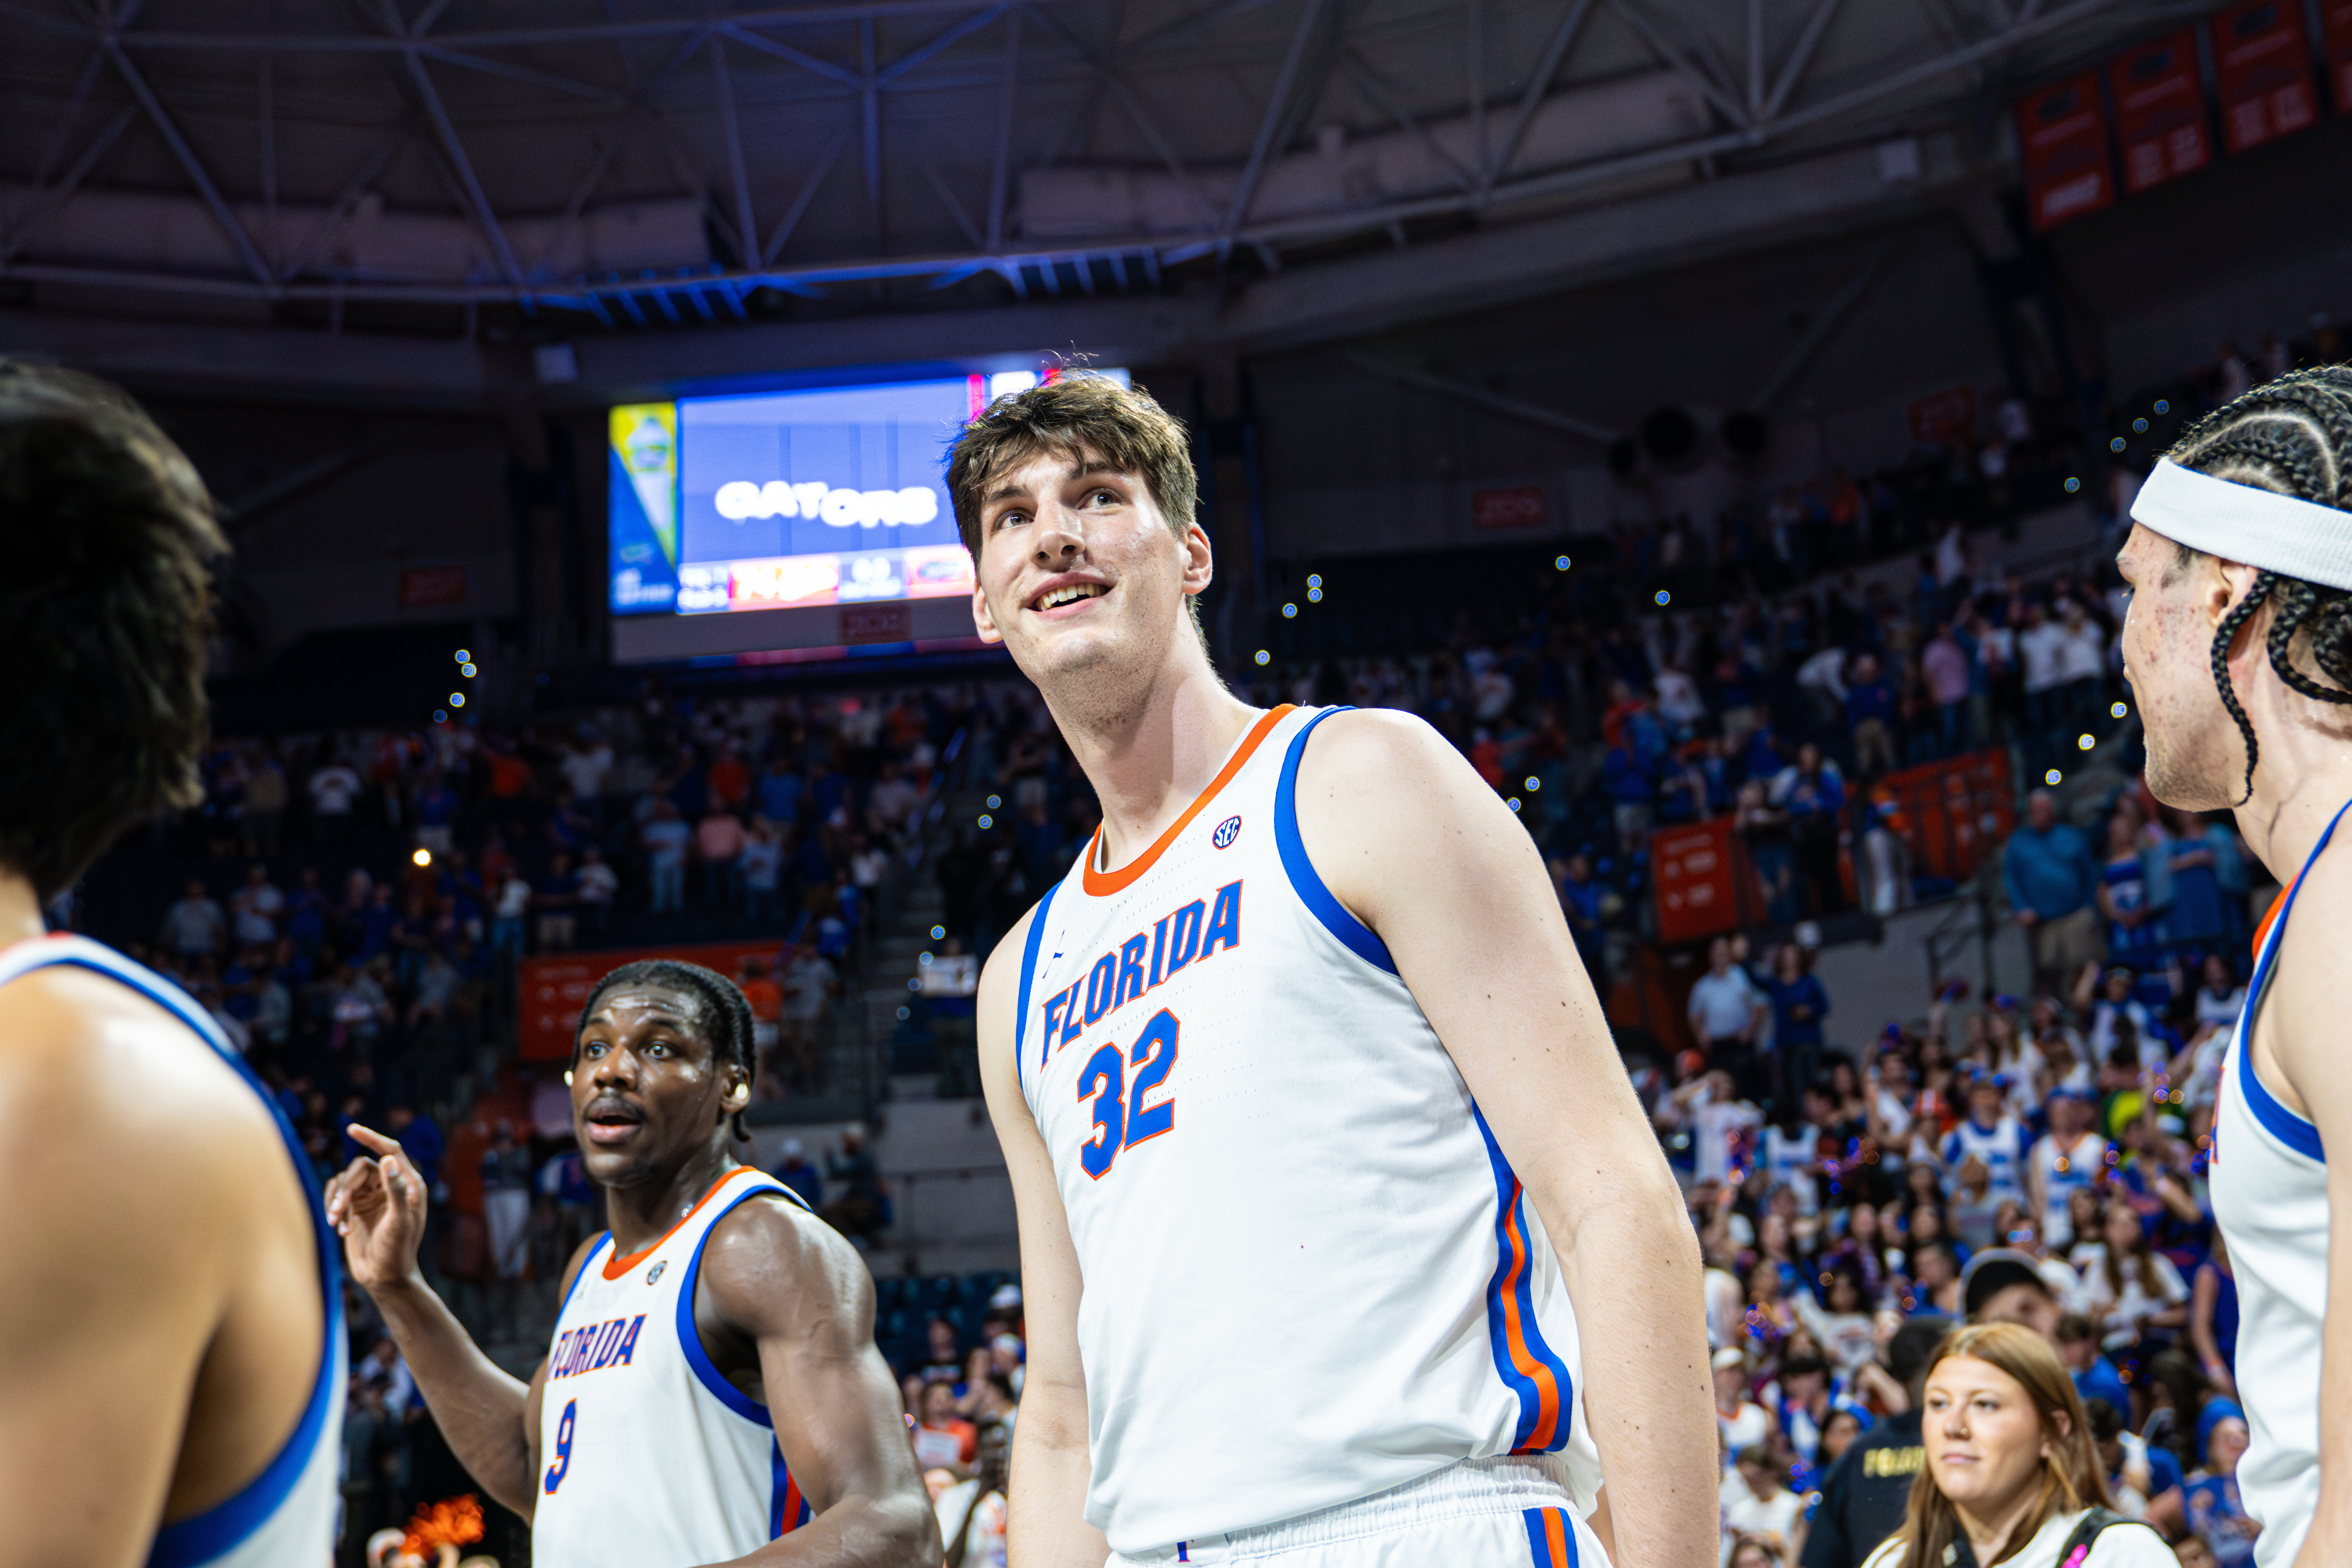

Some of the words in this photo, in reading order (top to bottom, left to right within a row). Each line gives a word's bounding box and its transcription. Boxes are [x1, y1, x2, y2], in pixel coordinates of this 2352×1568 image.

[1214, 817, 1240, 848] SEC
[1041, 879, 1243, 1074] FLORIDA
[1077, 1007, 1180, 1181] 32
[545, 1313, 647, 1382] FLORIDA
[545, 1398, 577, 1495] 9
